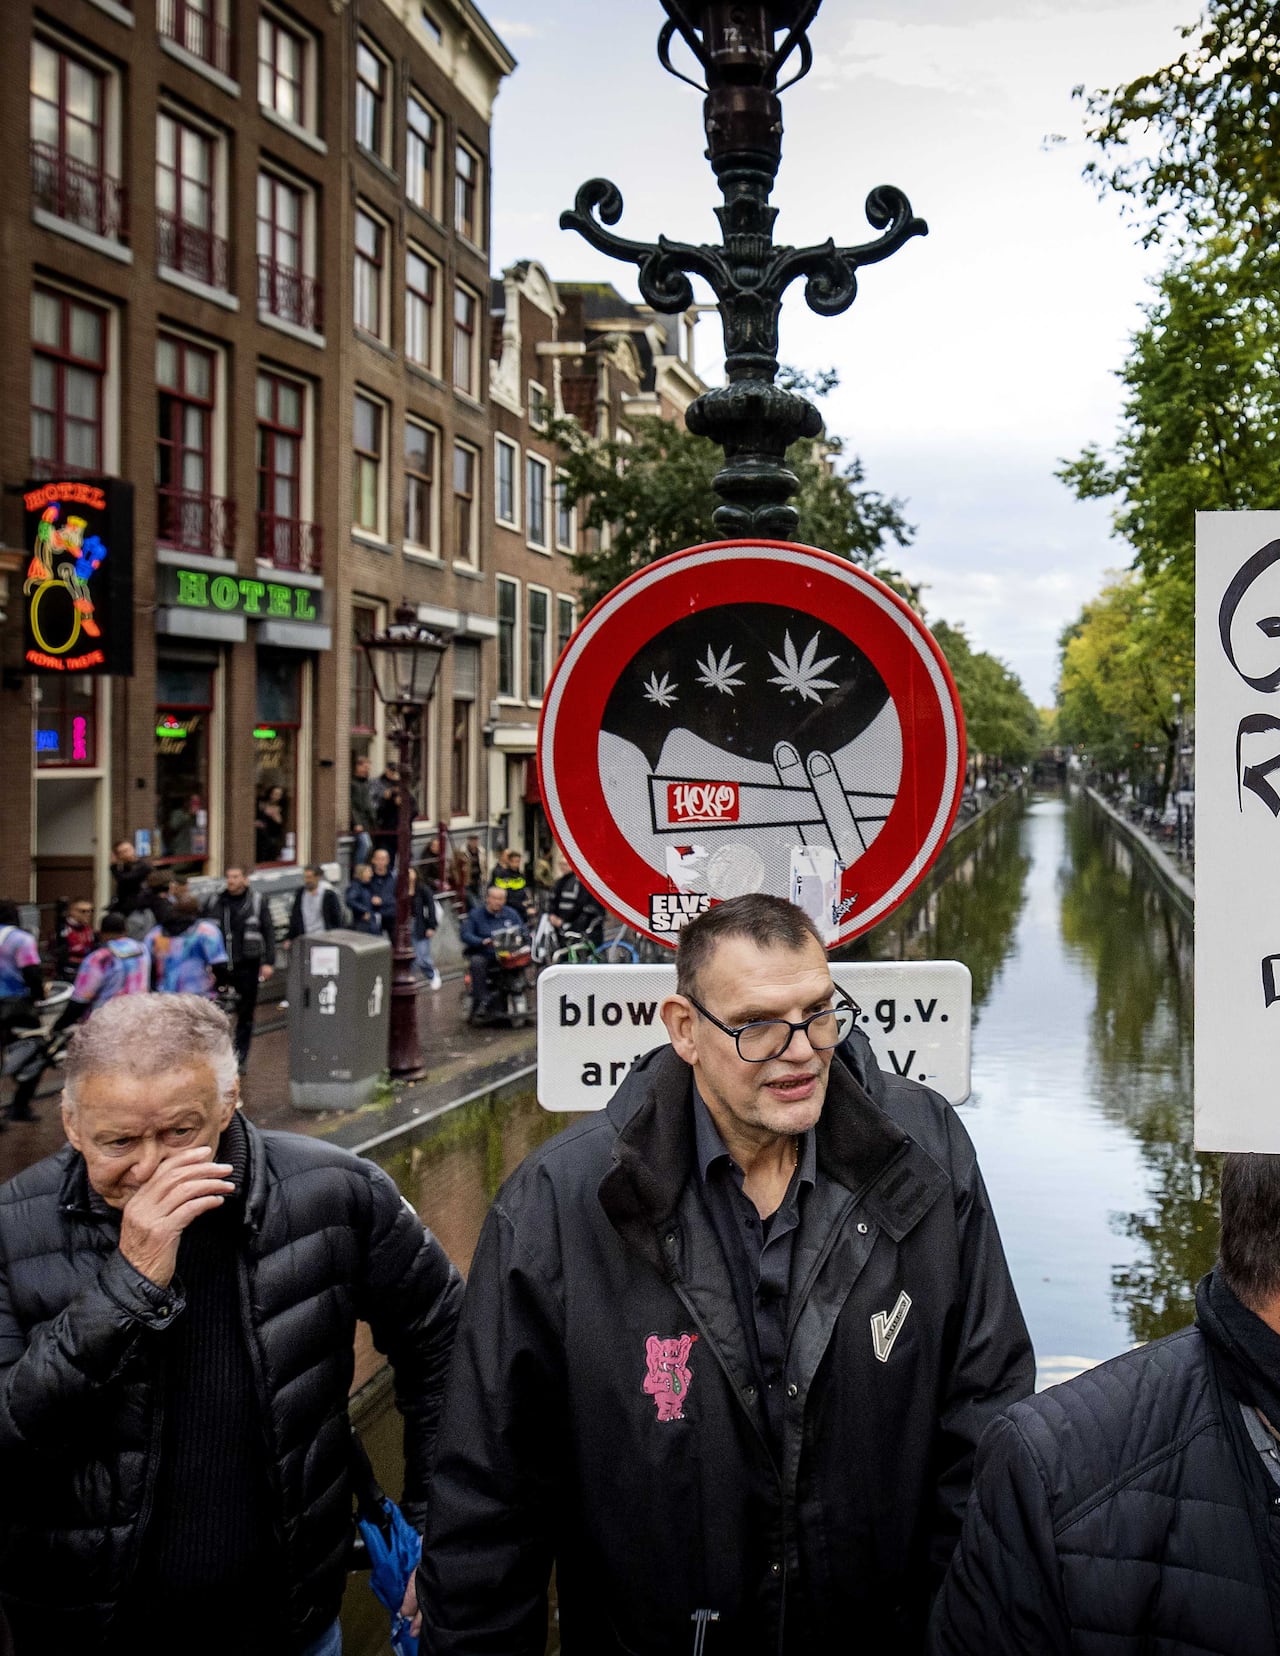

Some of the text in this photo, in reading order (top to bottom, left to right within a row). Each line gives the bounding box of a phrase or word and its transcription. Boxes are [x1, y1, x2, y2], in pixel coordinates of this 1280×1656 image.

[24, 482, 106, 512] HOTEL
[177, 571, 316, 621] HOTEL
[560, 994, 658, 1026] blow
[581, 1054, 641, 1086] ar
